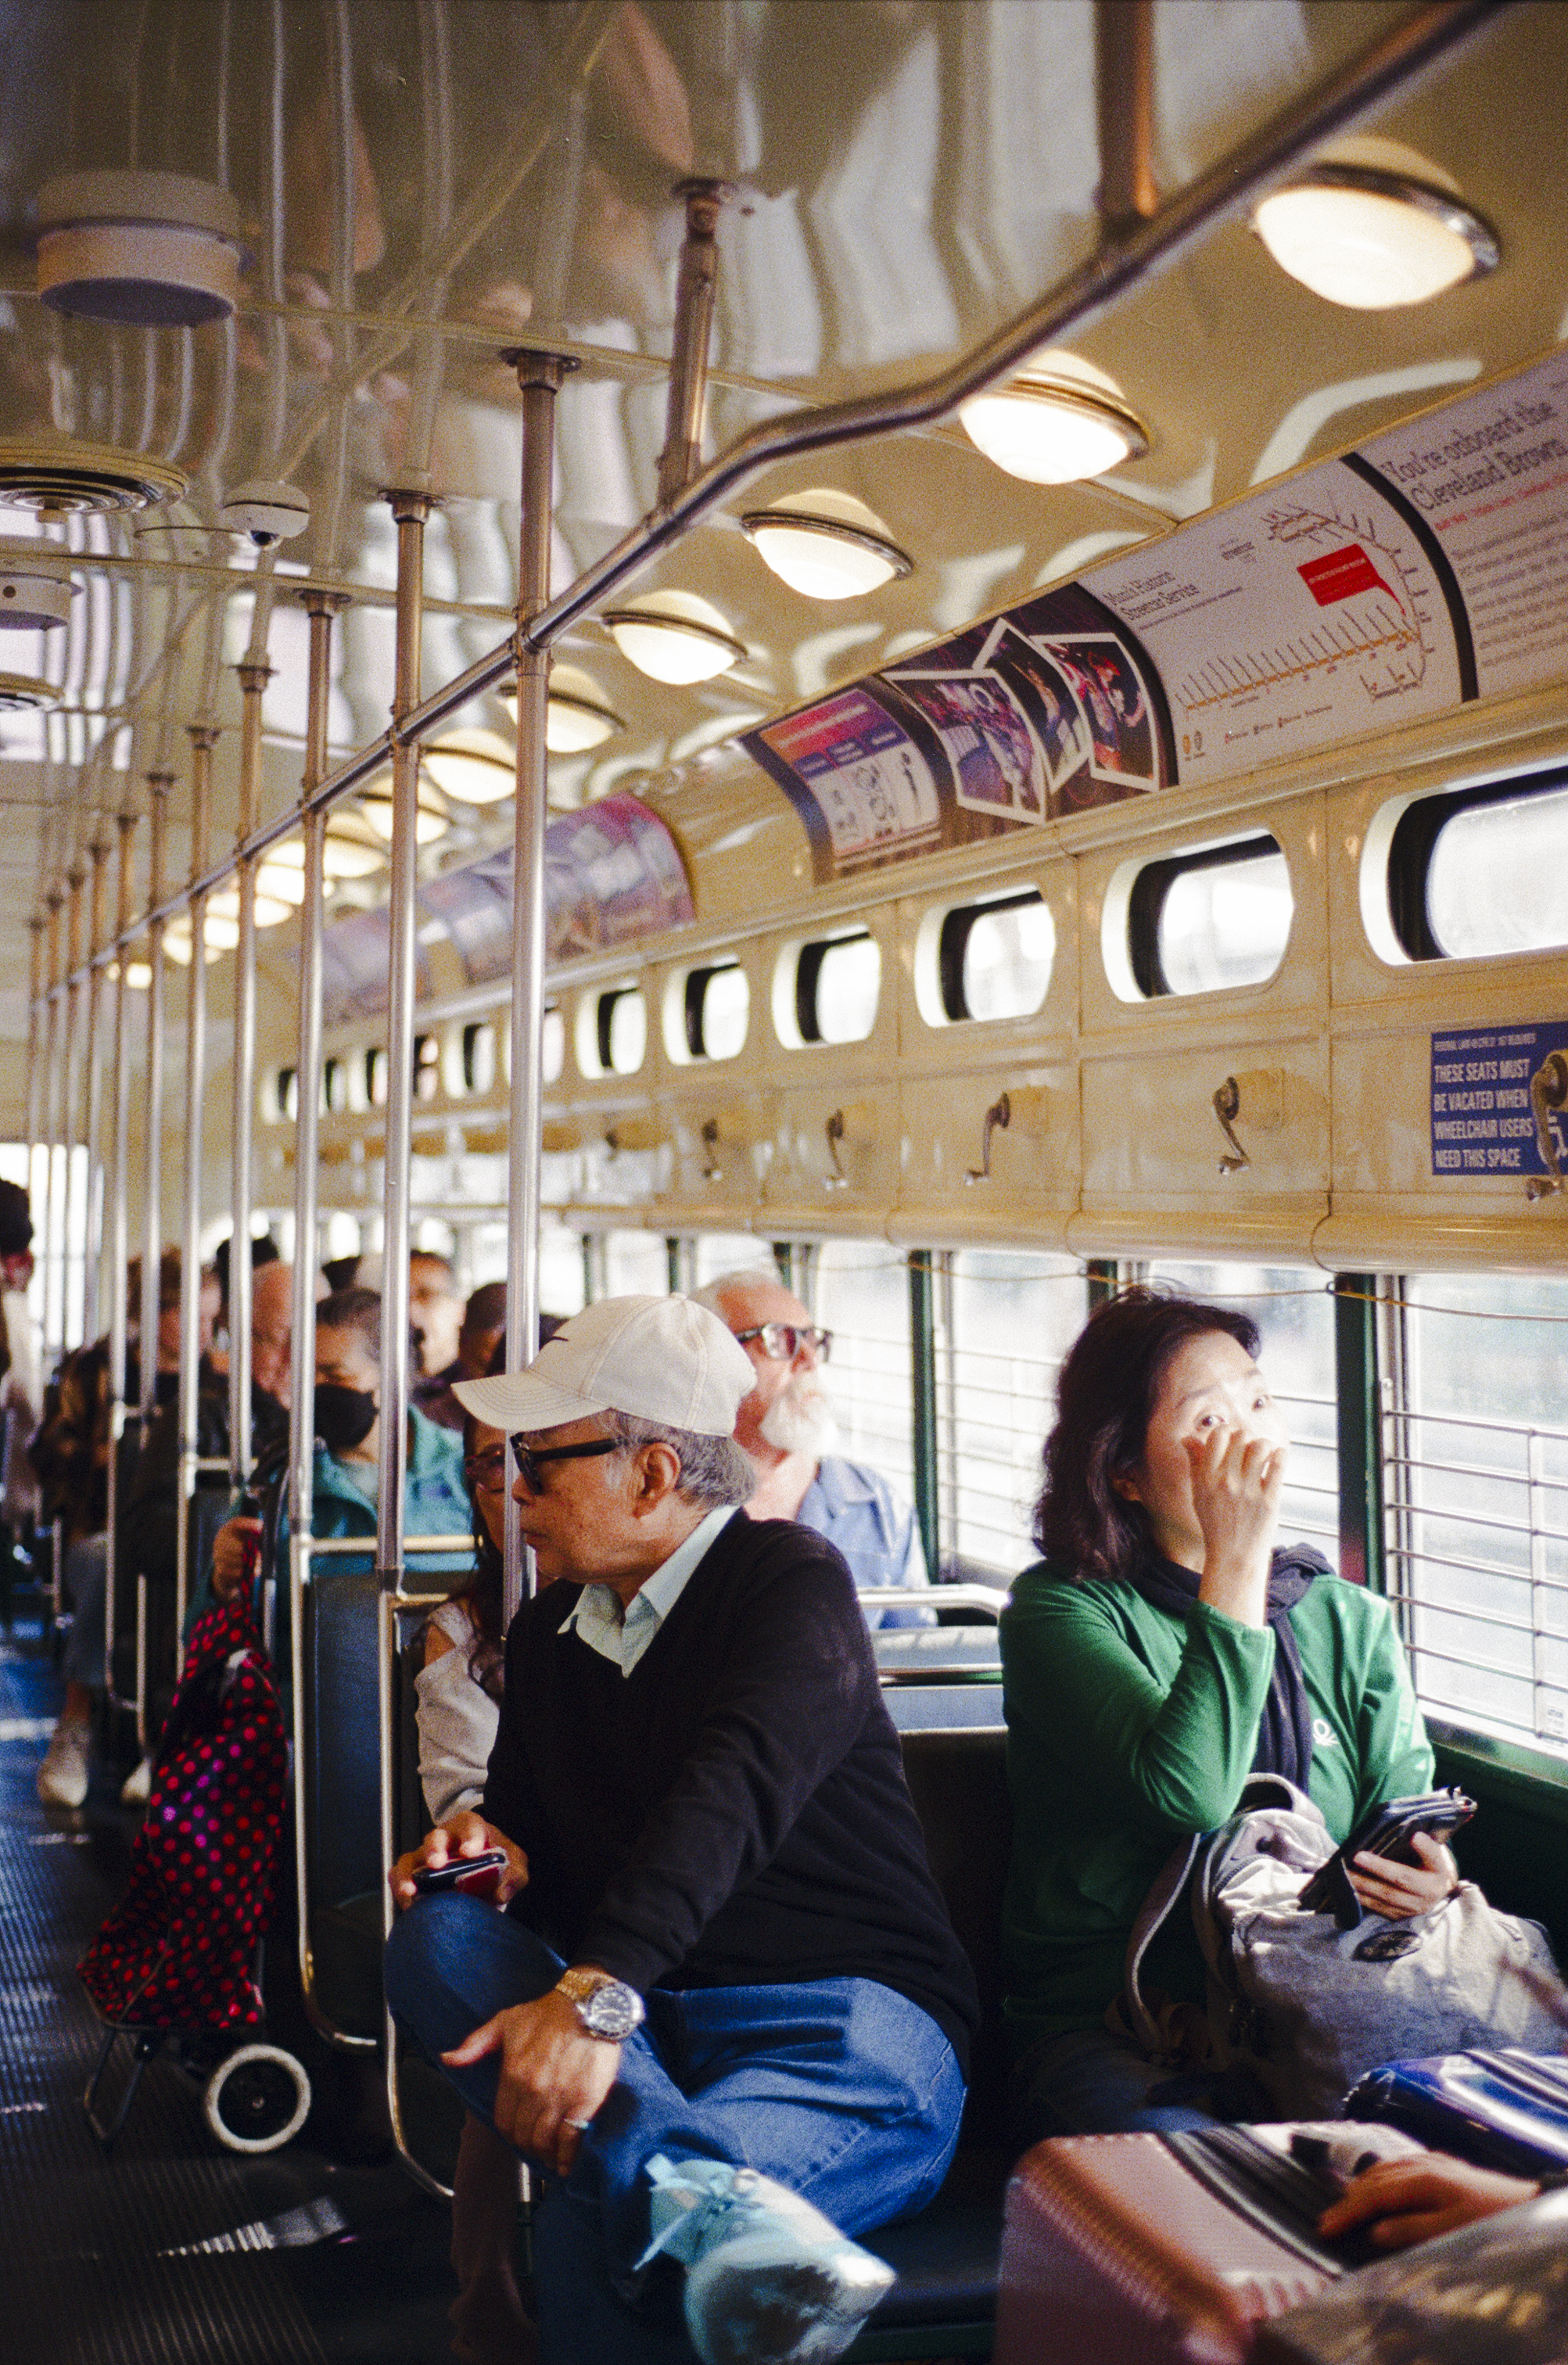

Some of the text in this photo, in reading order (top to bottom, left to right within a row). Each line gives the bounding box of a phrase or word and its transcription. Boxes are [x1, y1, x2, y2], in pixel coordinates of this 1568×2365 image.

[1380, 450, 1448, 483] You're
[1411, 455, 1506, 510] Cleveland
[1158, 583, 1200, 605] Service
[1433, 1058, 1530, 1083] THESE SEATS MUST
[1433, 1088, 1528, 1112] BE VACATED WHEN
[1433, 1118, 1534, 1139] WHEELCHAIR USERS
[1435, 1148, 1521, 1168] NEED THIS SPACE
